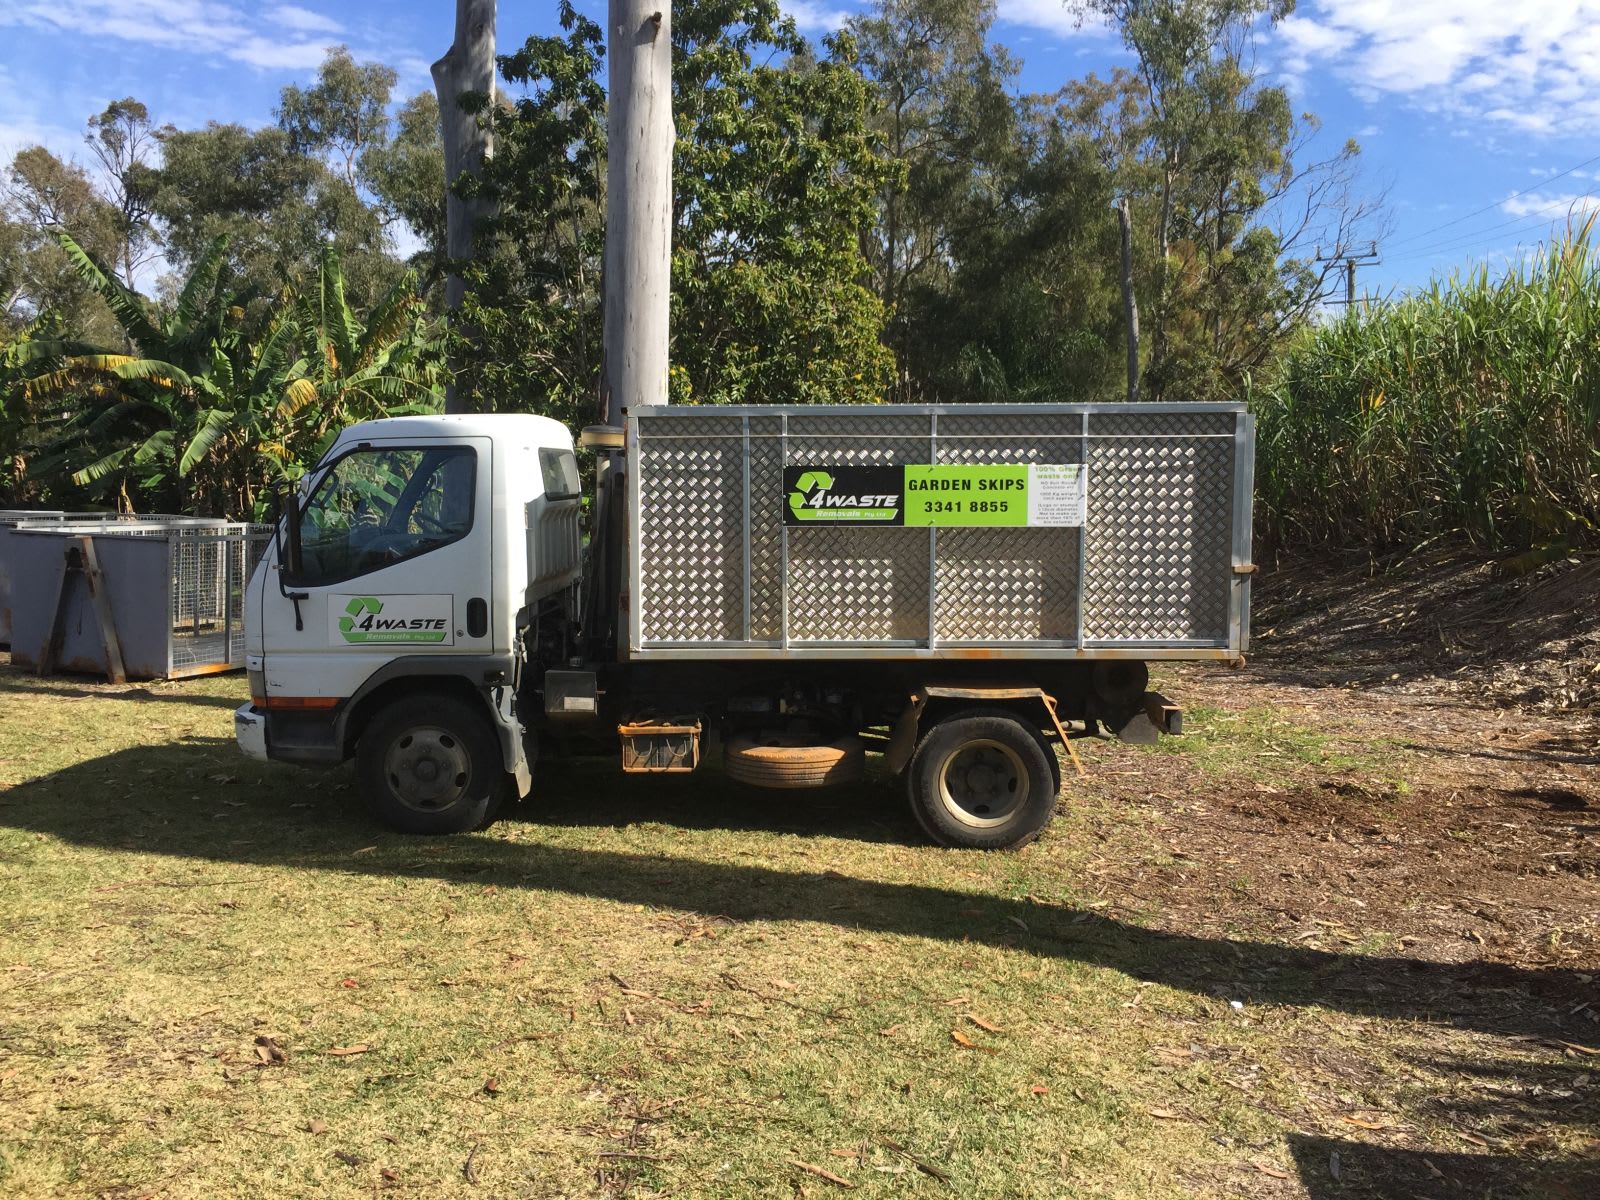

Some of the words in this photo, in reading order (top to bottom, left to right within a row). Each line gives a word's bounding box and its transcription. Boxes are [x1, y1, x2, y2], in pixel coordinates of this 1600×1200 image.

[908, 479, 971, 491] GARDEN
[978, 479, 1025, 490] SKIPS
[809, 490, 899, 508] 4WASTE
[924, 501, 961, 513] 3341
[969, 501, 1008, 513] 8855
[359, 614, 447, 631] 4WASTE
